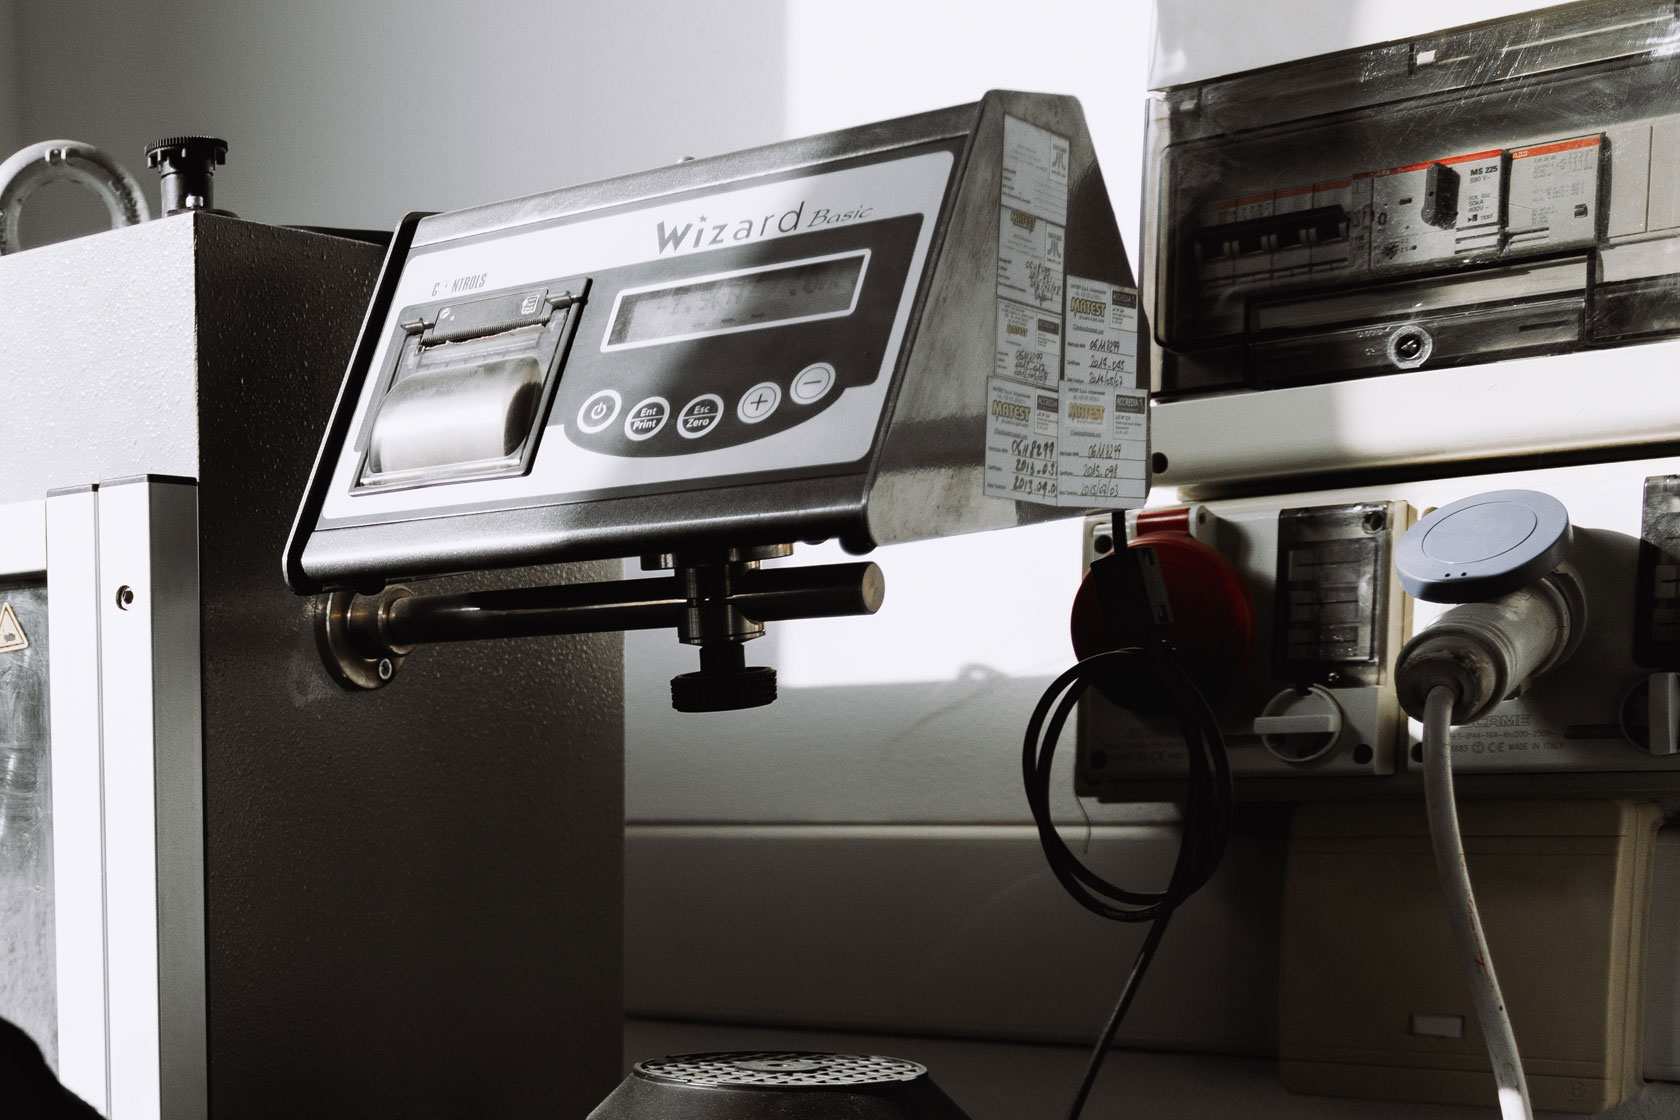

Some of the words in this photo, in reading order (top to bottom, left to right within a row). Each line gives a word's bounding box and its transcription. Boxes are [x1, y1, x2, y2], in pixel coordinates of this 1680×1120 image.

[1470, 167, 1484, 176] MS
[1484, 165, 1498, 174] 225
[656, 200, 805, 255] Wizard
[807, 204, 874, 229] Basic
[432, 273, 488, 297] CNTROLS
[1070, 296, 1107, 318] MATEST
[640, 407, 658, 418] Ent
[693, 404, 710, 415] Esc
[991, 399, 1031, 422] MATEST
[631, 418, 657, 431] Print
[685, 417, 710, 428] Zero
[1508, 742, 1529, 752] MADE
[1531, 742, 1540, 751] IN
[1543, 741, 1564, 750] ITALY
